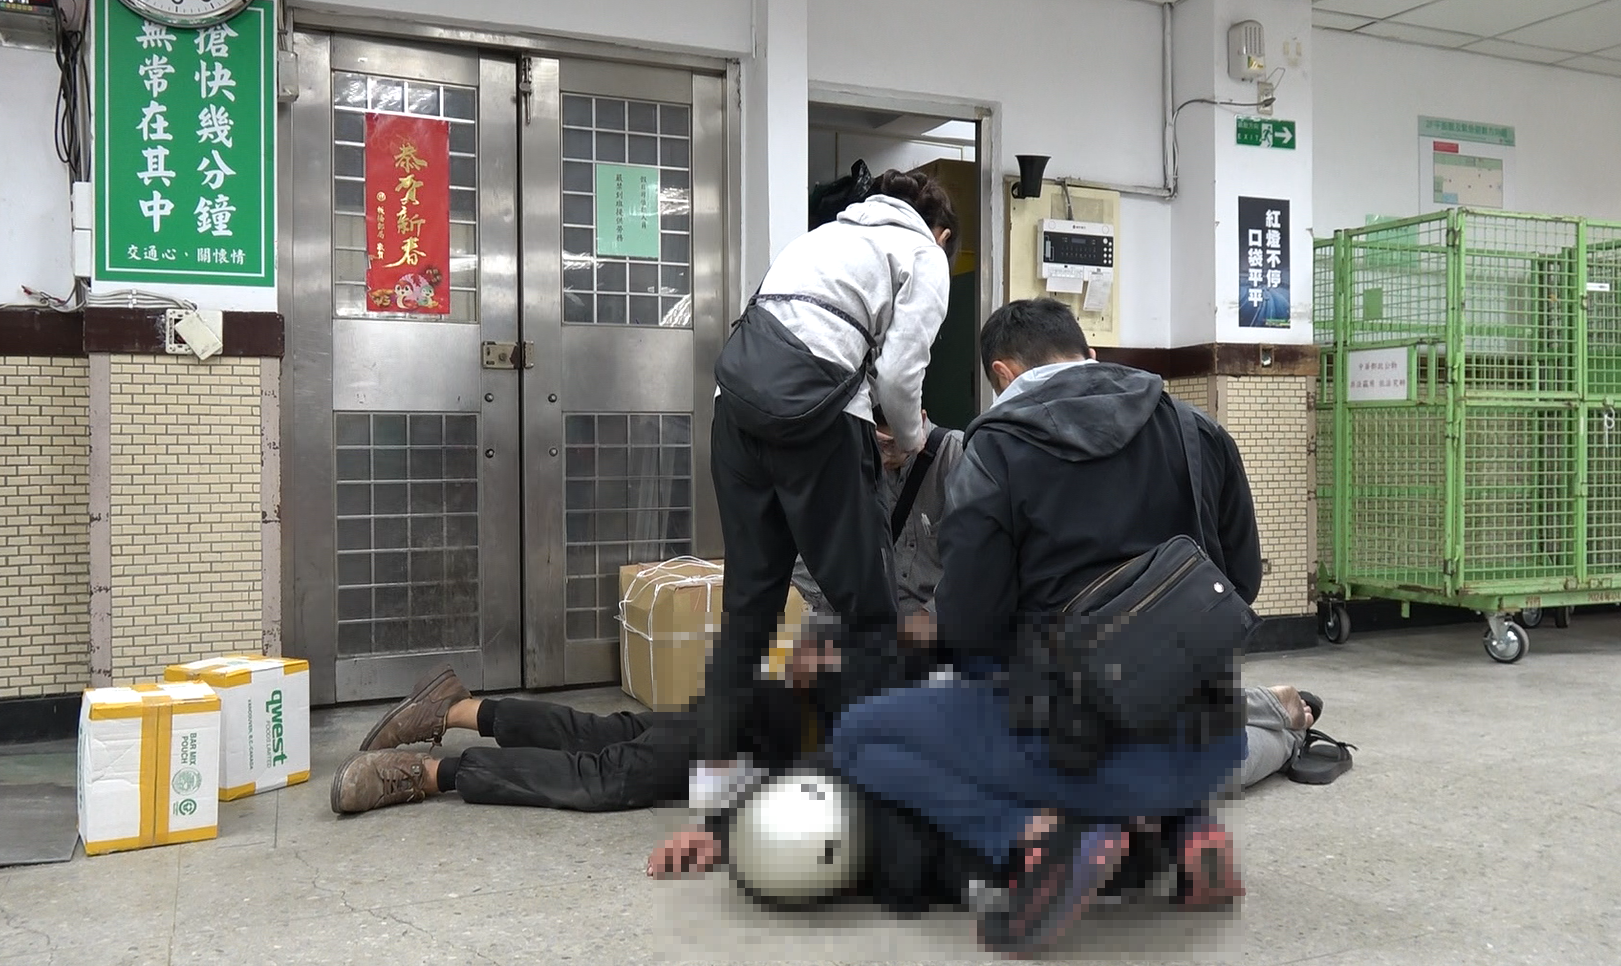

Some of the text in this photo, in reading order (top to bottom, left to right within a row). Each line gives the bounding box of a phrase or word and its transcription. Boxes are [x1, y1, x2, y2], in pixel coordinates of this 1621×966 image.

[135, 20, 177, 233] 無常在其中
[193, 22, 239, 236] 搶快幾分鐘
[1237, 133, 1259, 141] EXIT
[382, 142, 428, 268] 恭賀新春
[127, 244, 246, 266] 交通心、關懷情
[1247, 228, 1263, 308] 口袋平平
[1265, 209, 1281, 288] 紅燈不停
[181, 736, 189, 764] POUCH
[189, 751, 197, 766] MIX
[266, 689, 287, 767] qwest
